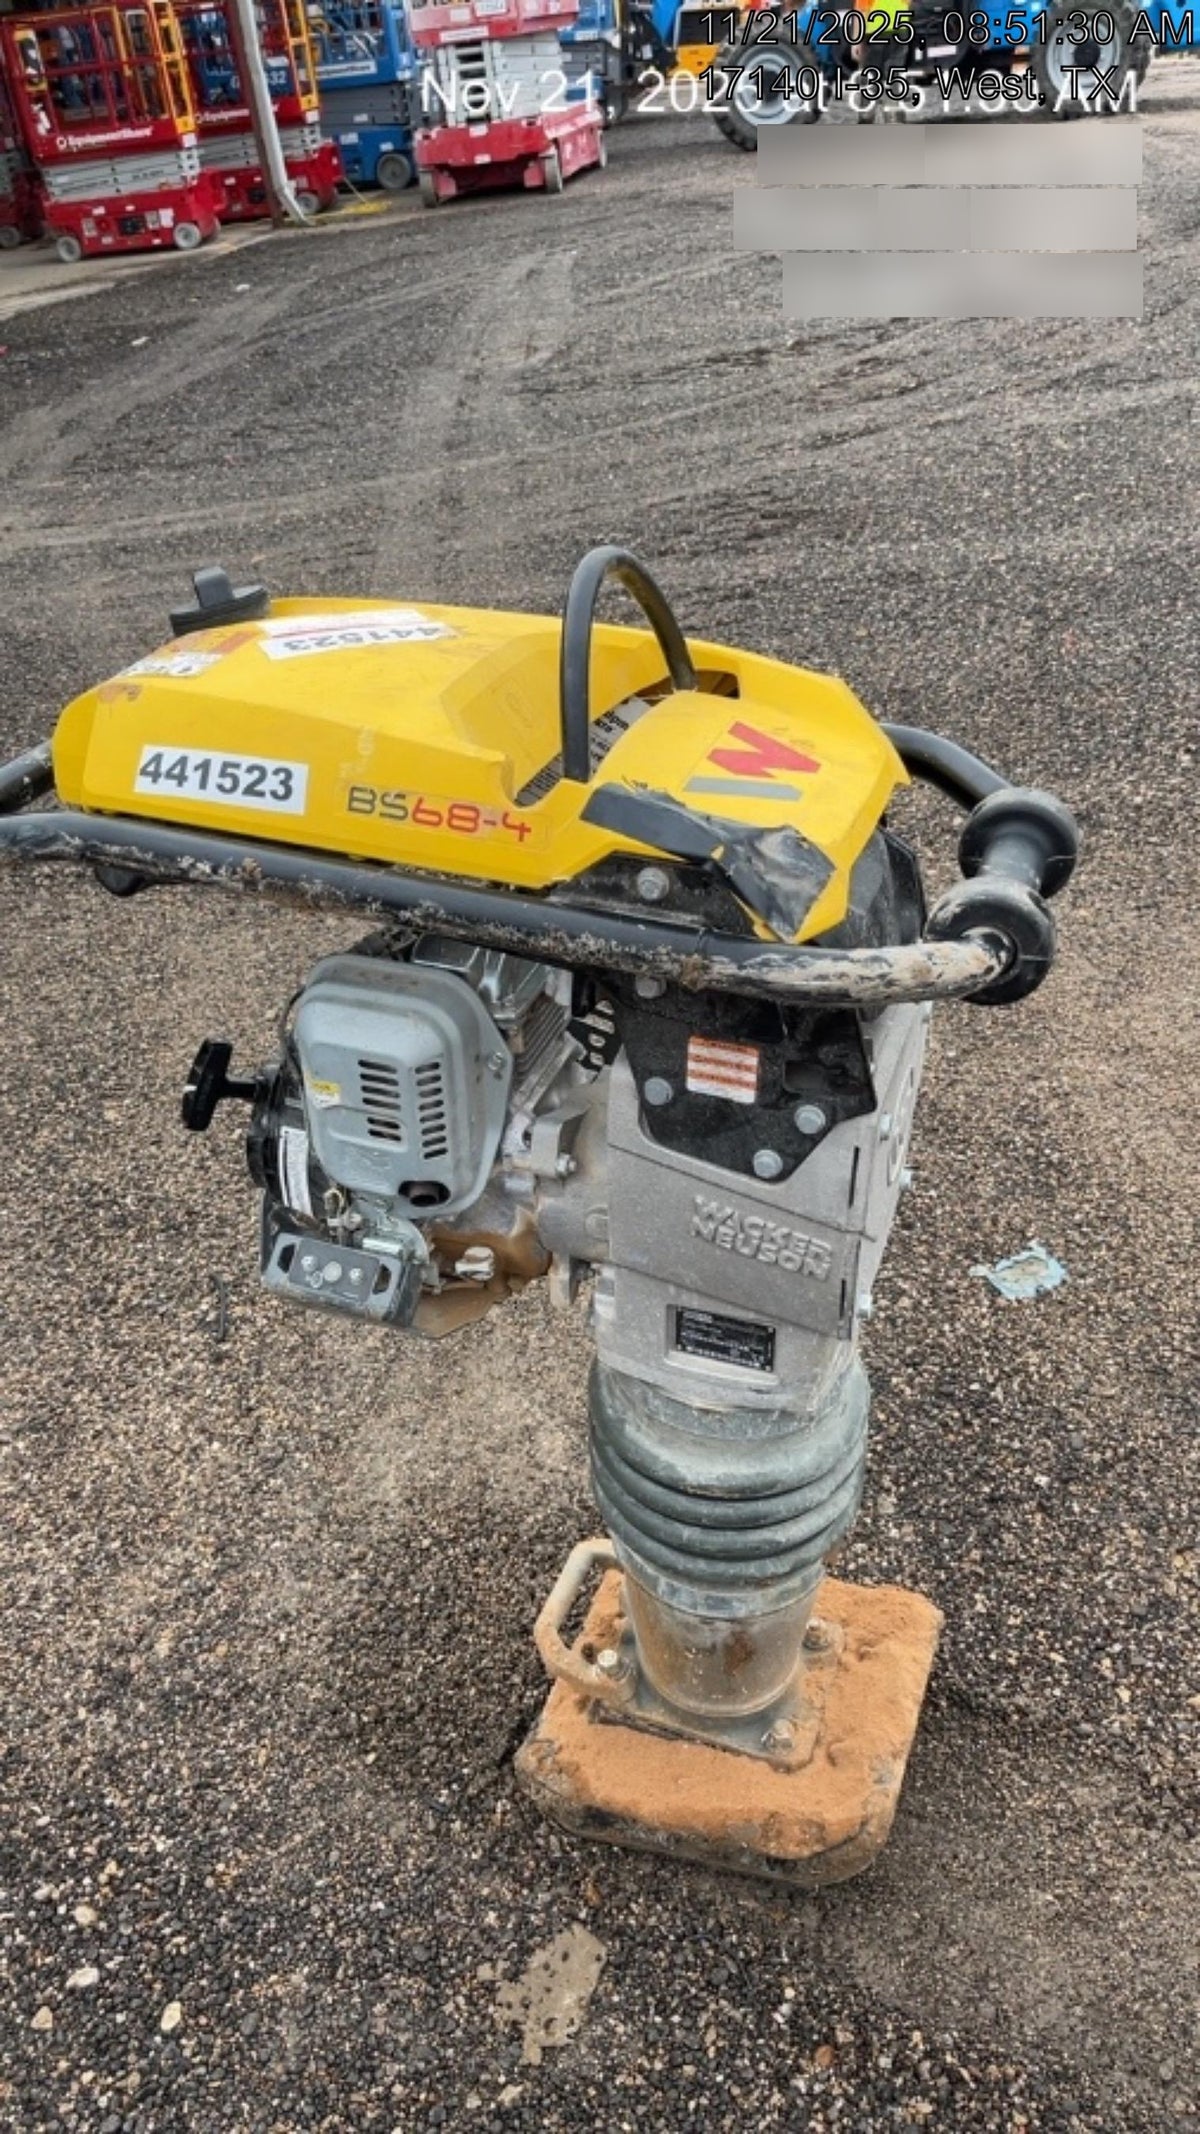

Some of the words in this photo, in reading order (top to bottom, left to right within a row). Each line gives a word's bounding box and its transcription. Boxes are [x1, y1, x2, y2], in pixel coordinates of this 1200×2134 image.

[282, 625, 441, 652] 441523
[139, 752, 294, 801] 441523
[347, 786, 532, 843] BS68-4
[690, 1215, 832, 1282] NEUSON
[694, 1195, 832, 1262] WACKER
